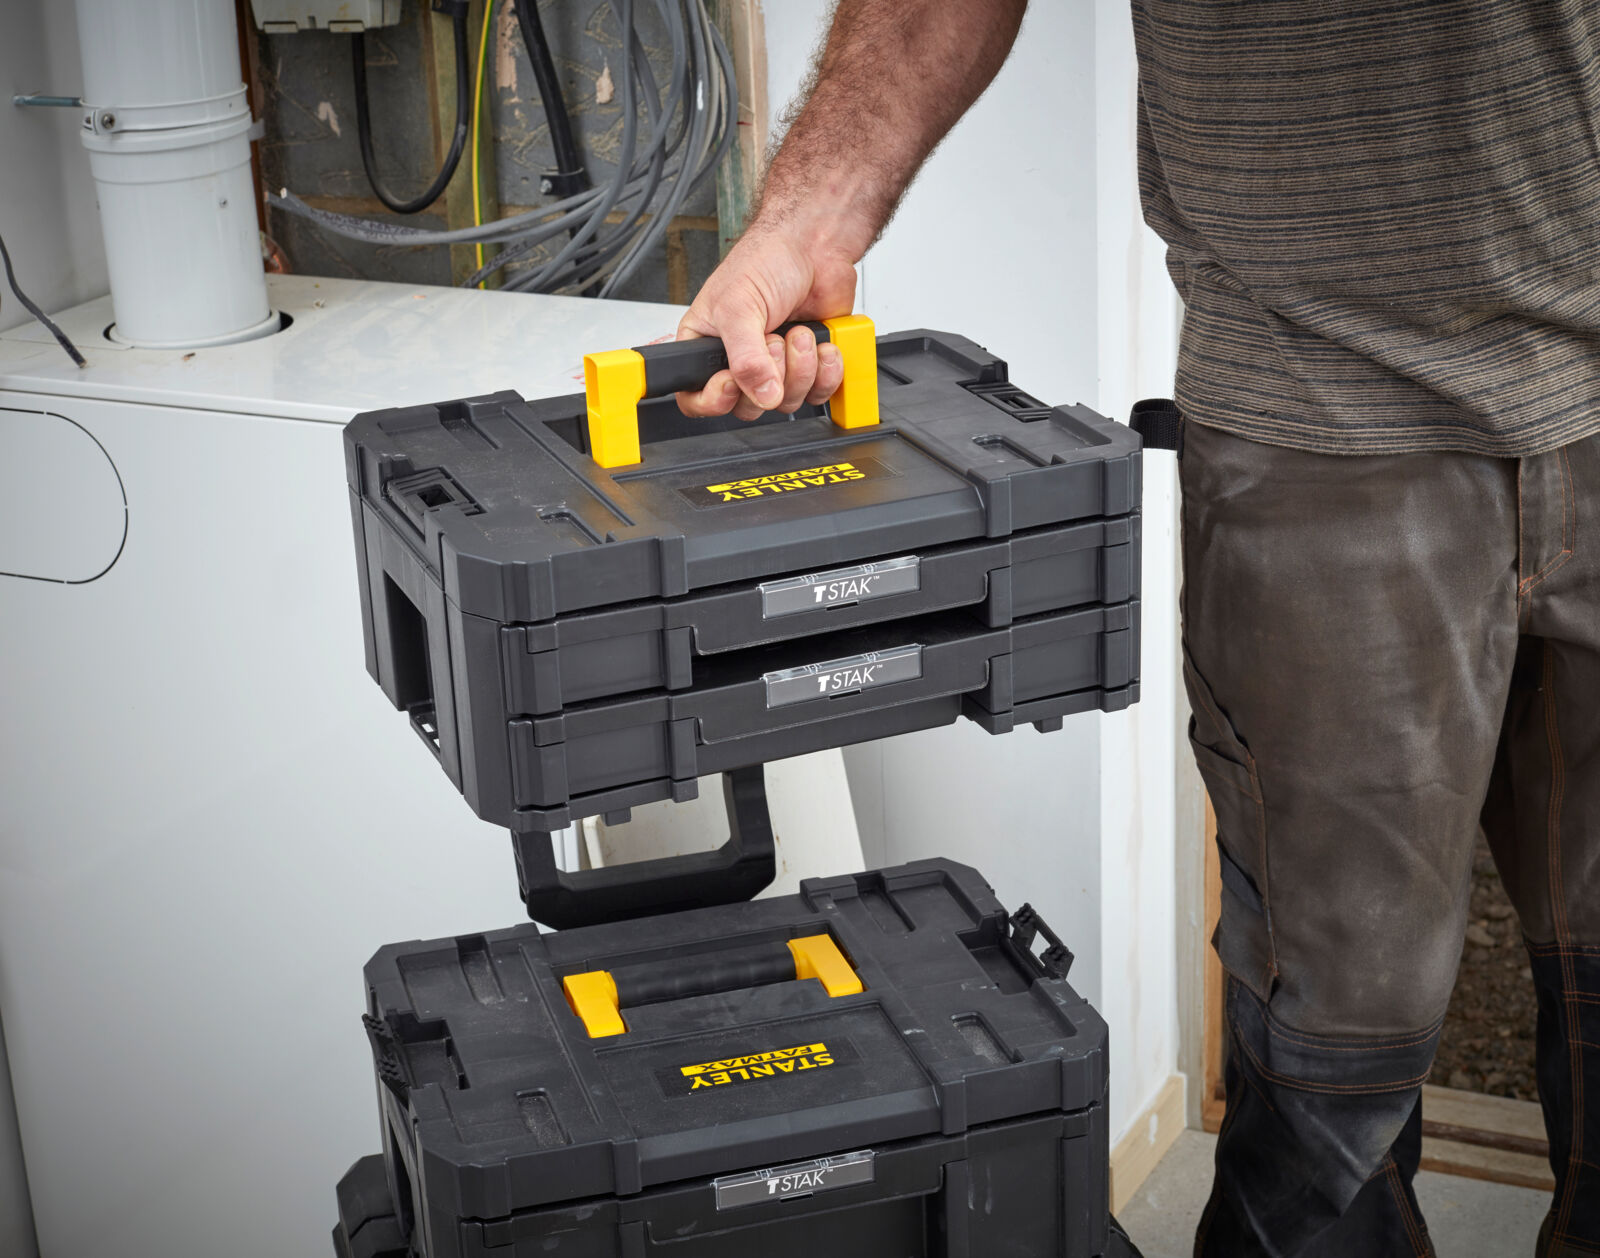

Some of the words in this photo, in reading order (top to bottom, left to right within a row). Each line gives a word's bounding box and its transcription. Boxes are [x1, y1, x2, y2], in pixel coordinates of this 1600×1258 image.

[722, 469, 866, 502] STANLEY
[728, 465, 841, 489] FATMAX
[690, 1053, 835, 1090] STANLEY
[702, 1046, 814, 1072] FATMAX
